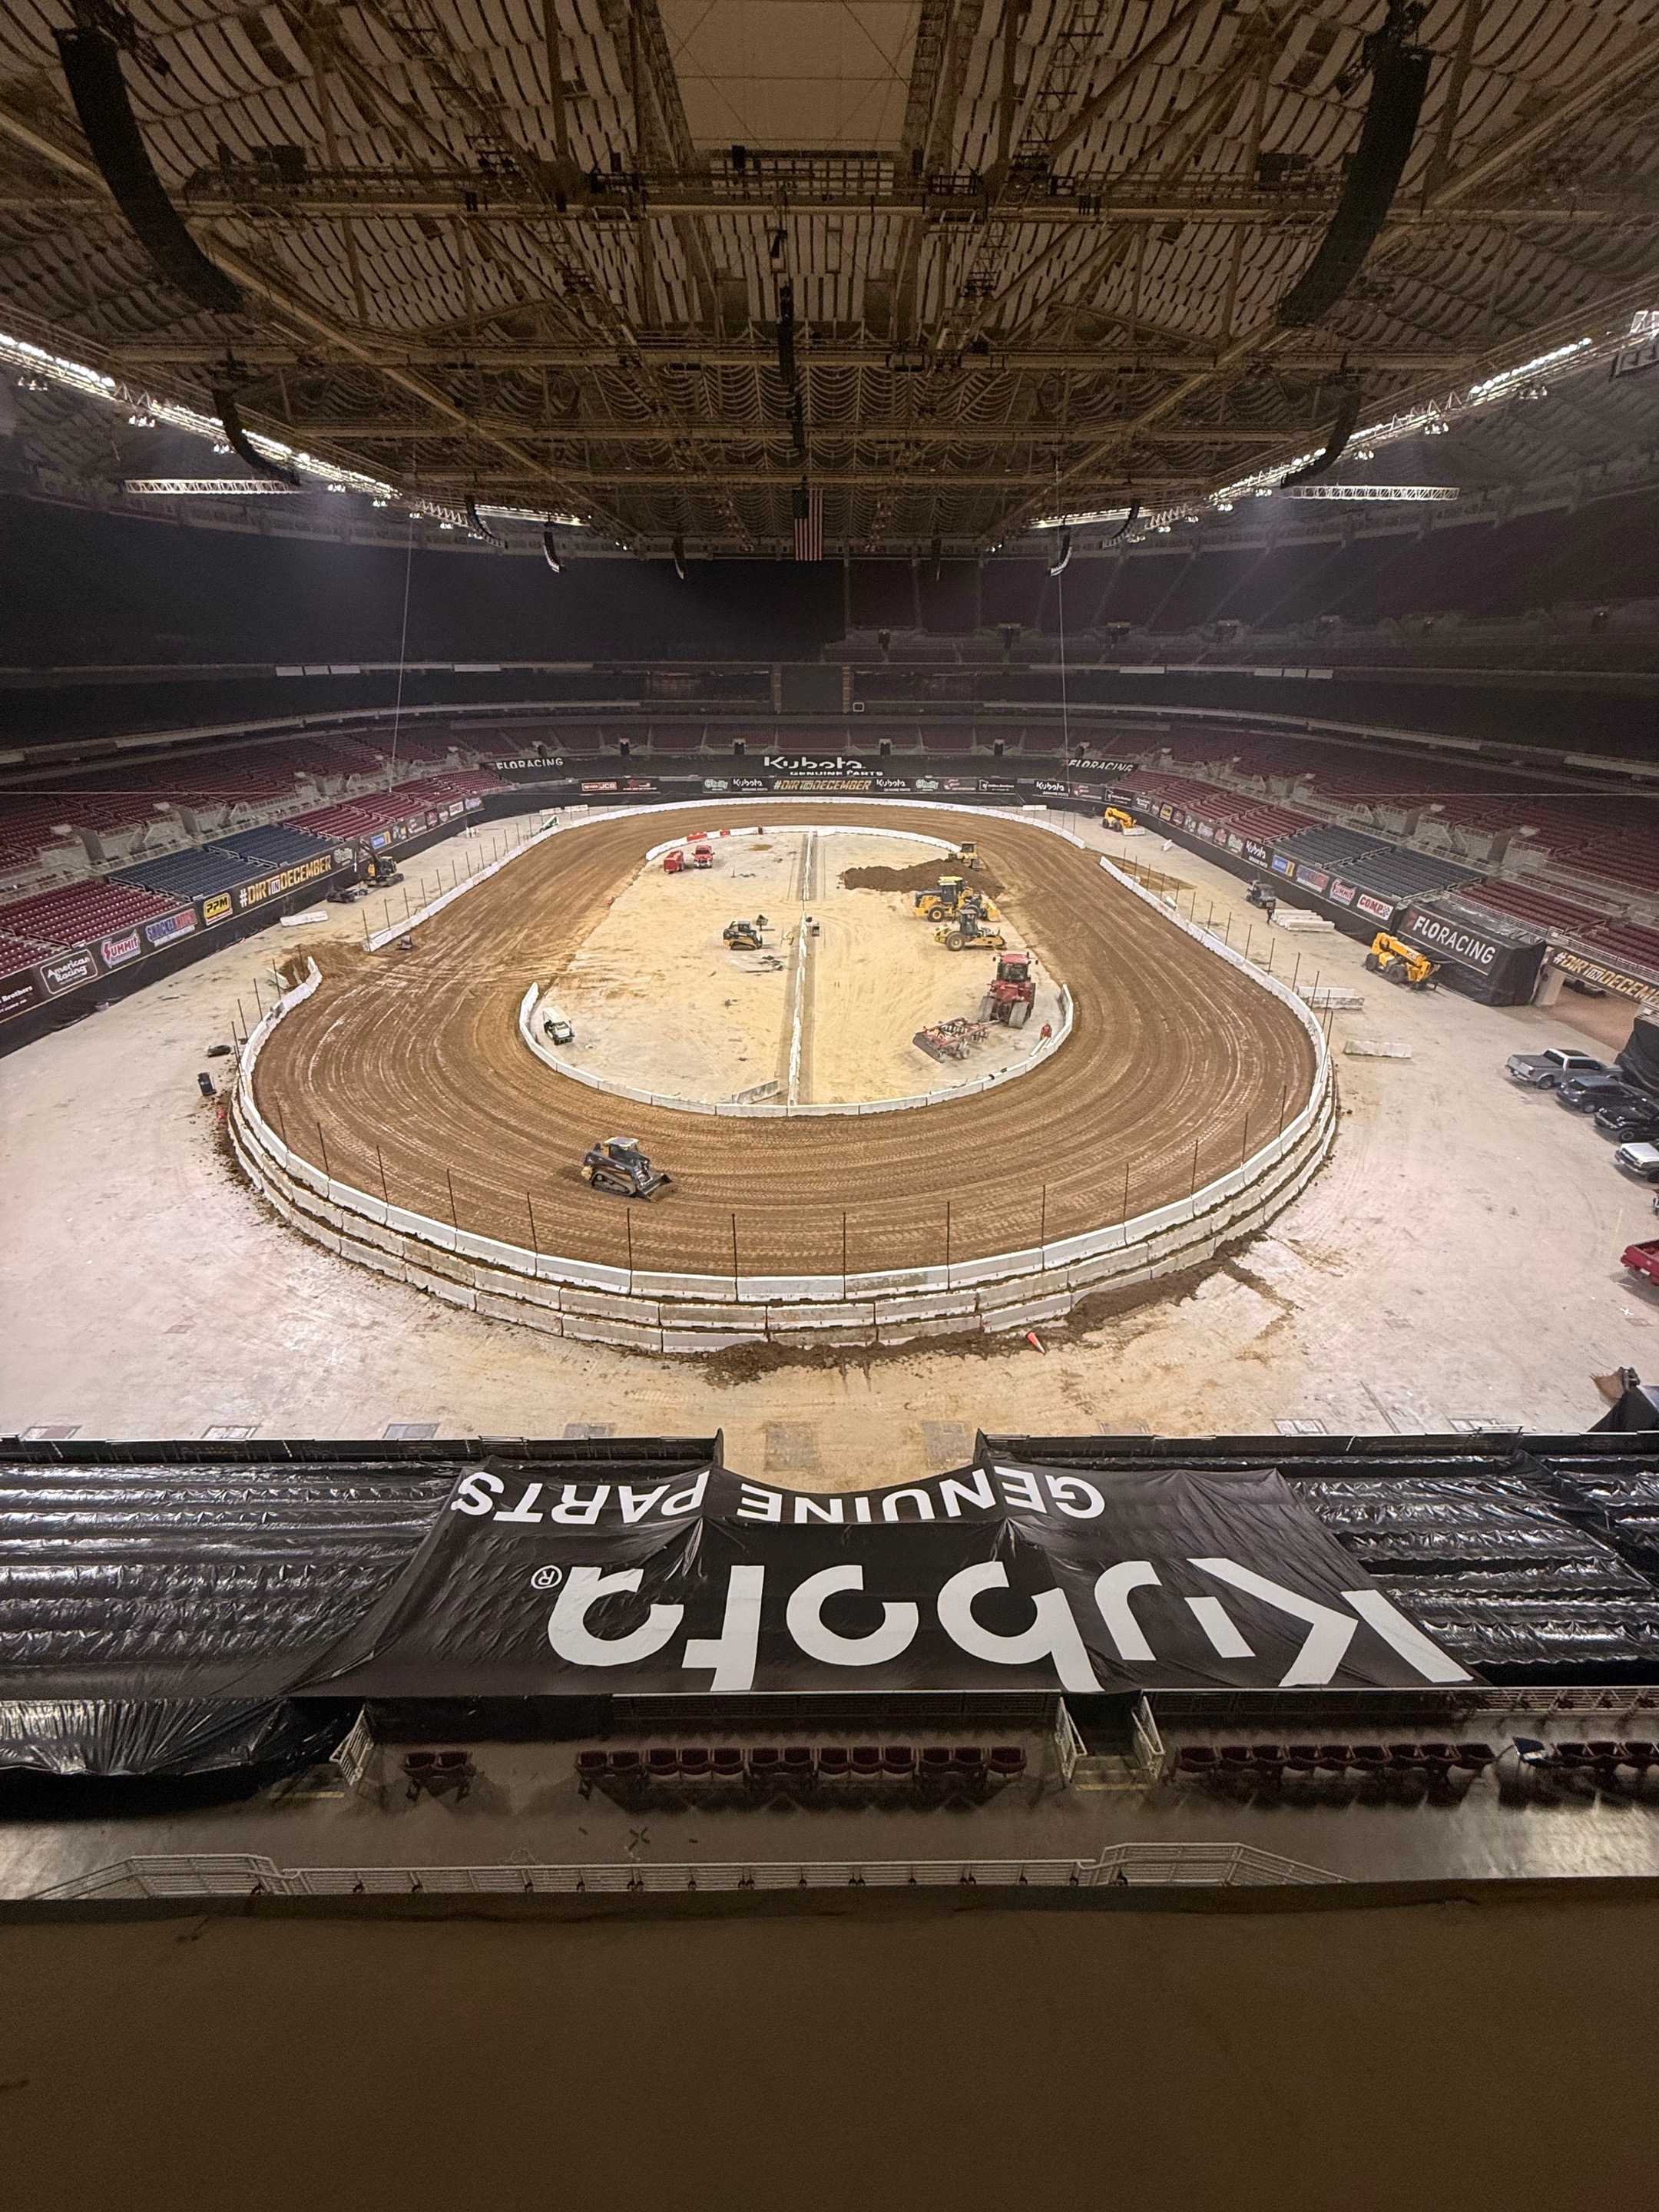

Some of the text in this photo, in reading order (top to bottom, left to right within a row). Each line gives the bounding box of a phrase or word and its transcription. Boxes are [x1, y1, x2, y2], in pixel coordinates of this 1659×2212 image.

[496, 757, 564, 770] FLORACING
[763, 756, 863, 769] Kubota
[733, 778, 763, 786] Kubota
[876, 778, 906, 787] Kubota
[1036, 781, 1065, 791] Kubota
[206, 896, 229, 914] PPM
[1412, 915, 1497, 965] FLORACING
[48, 956, 91, 979] American
[450, 1465, 1105, 1525] GENUINE PARTS
